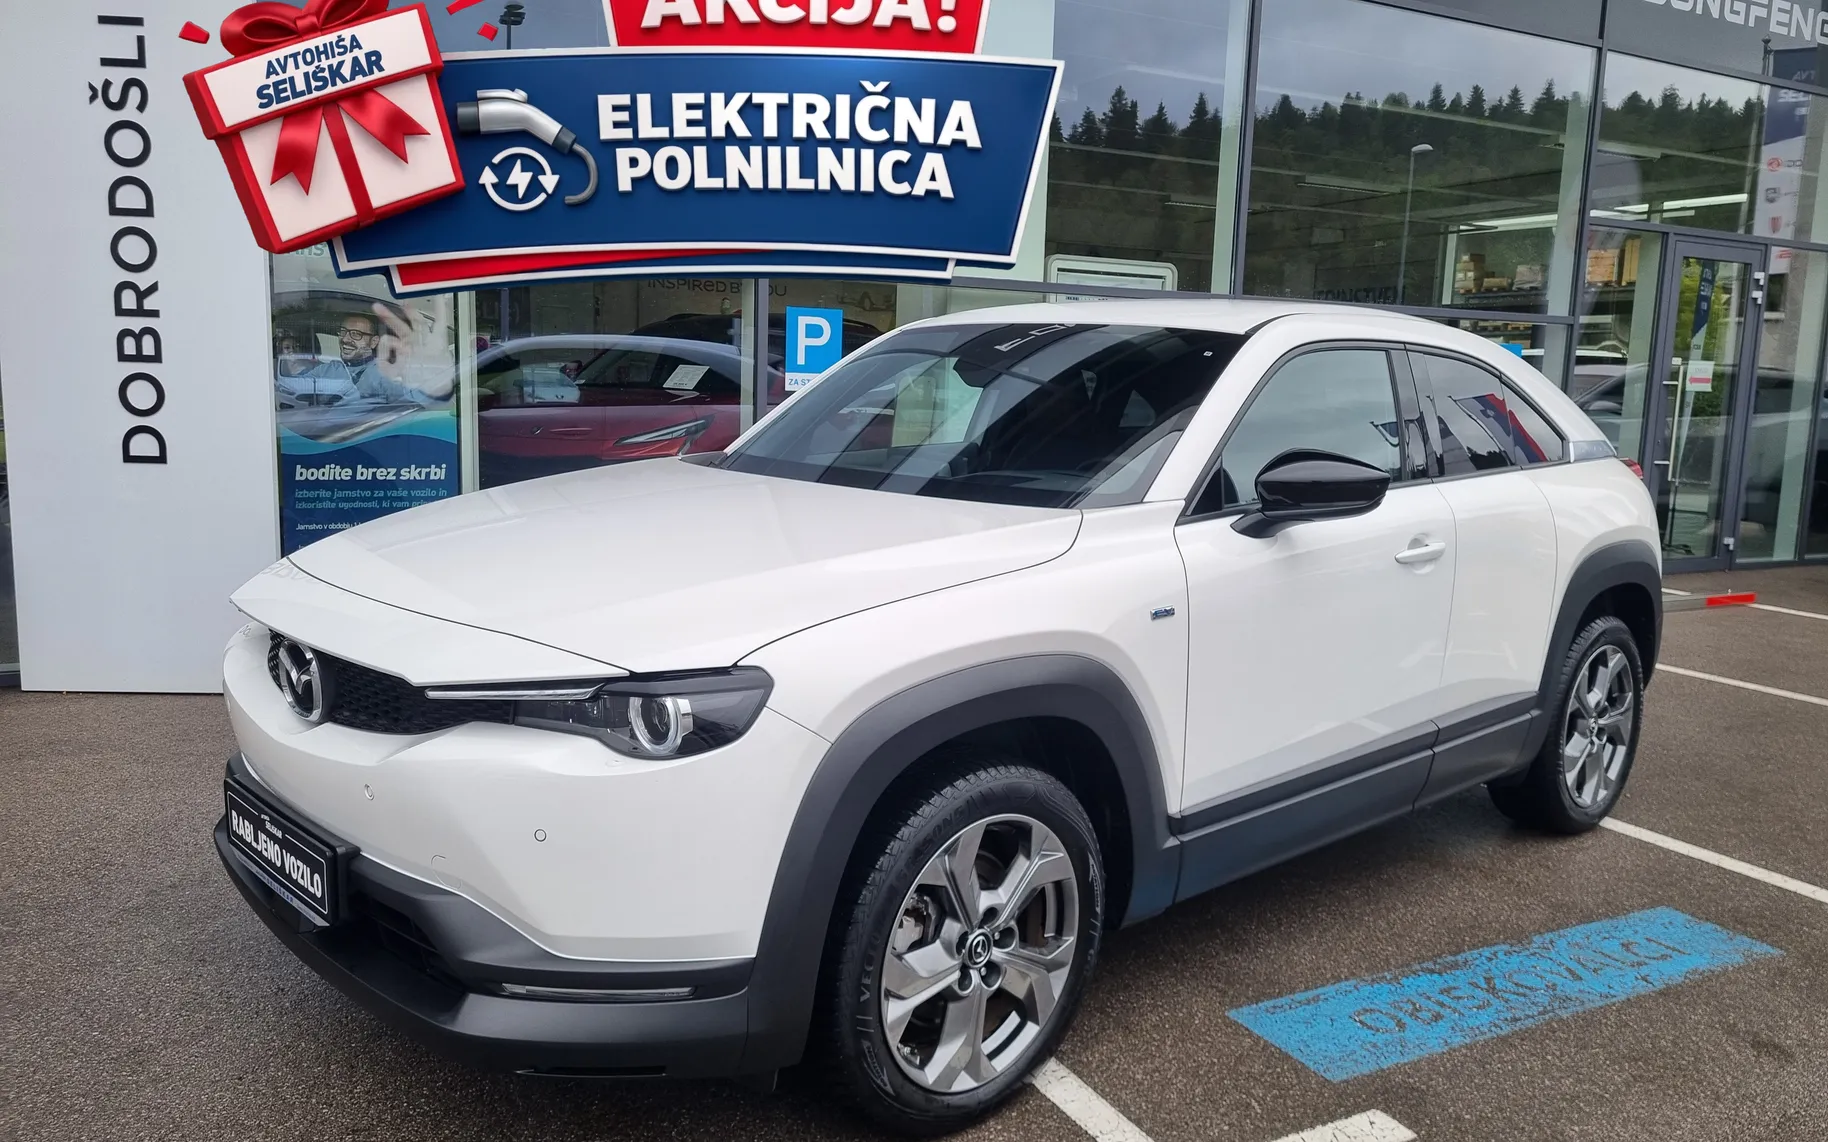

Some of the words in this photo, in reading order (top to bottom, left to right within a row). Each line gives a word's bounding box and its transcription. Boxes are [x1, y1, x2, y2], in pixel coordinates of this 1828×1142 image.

[88, 15, 167, 465] DOBRODOŠLI
[295, 464, 352, 481] bodite
[356, 464, 397, 481] brez
[400, 463, 447, 480] skrbi
[295, 488, 331, 498] izberite
[333, 489, 371, 501] jamstvo
[374, 490, 384, 498] za
[387, 489, 408, 497] vaše
[411, 488, 437, 497] vozilo
[439, 488, 447, 496] in
[295, 500, 336, 509] izkoristite
[382, 500, 390, 508] ki
[232, 809, 282, 868] RABLJENO
[282, 848, 322, 898] VOZILO
[1350, 936, 1692, 1034] OBISKOVALCI
